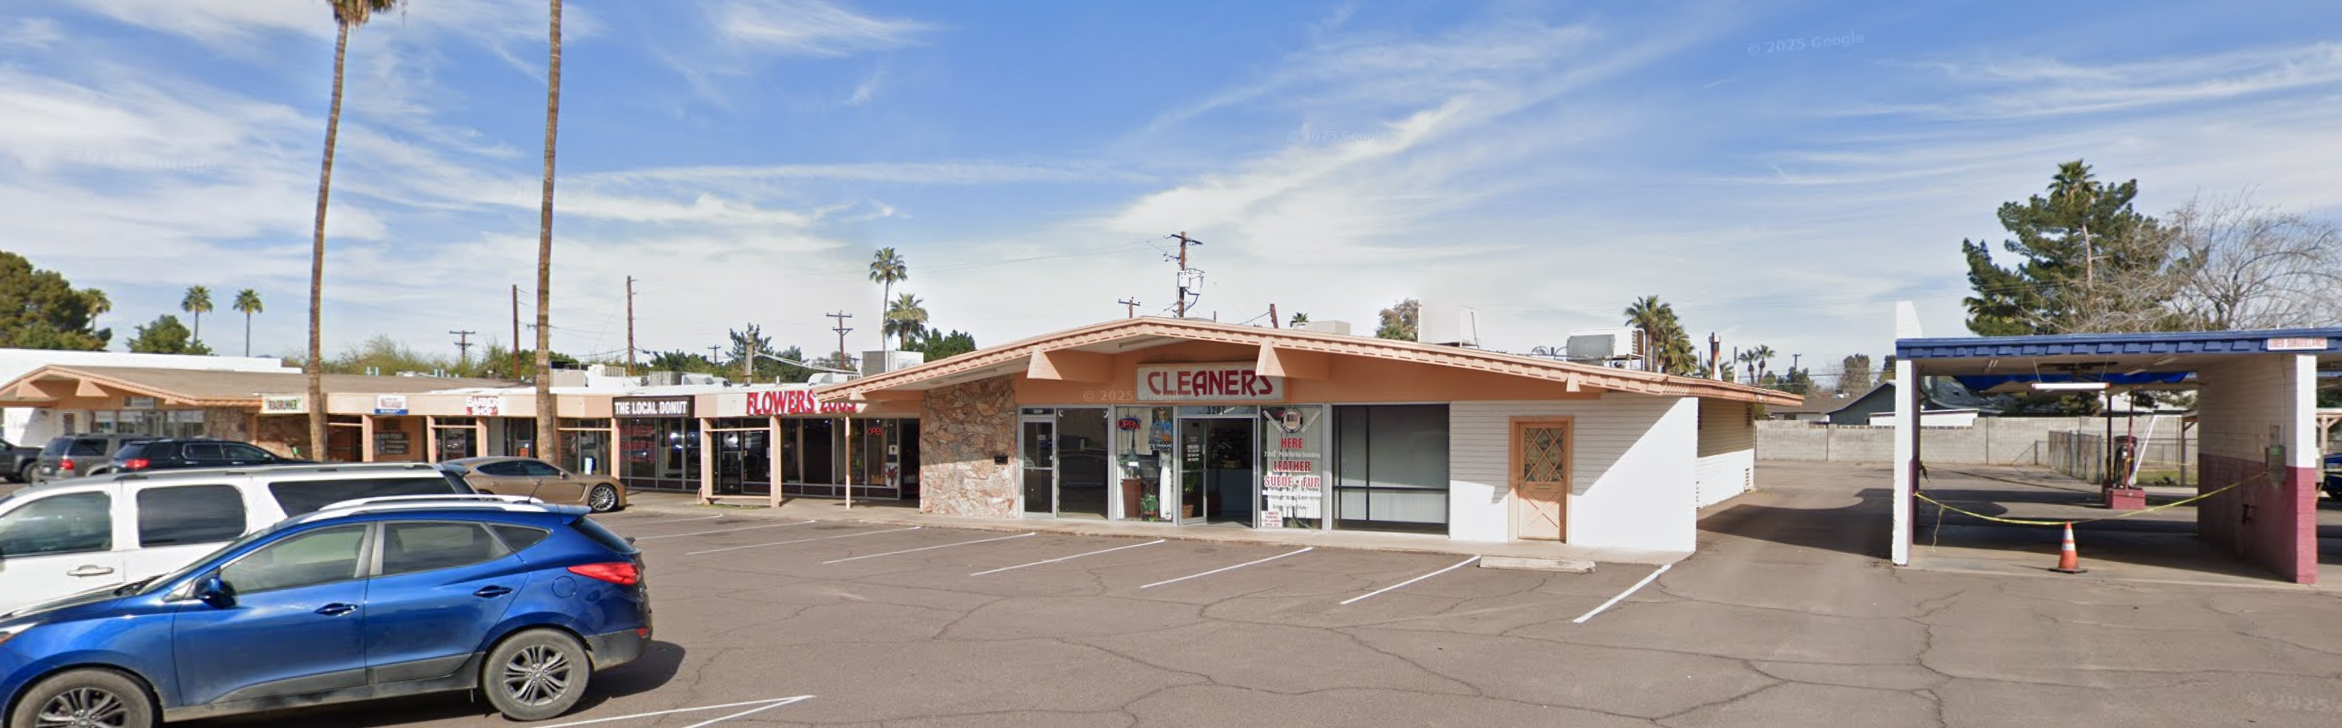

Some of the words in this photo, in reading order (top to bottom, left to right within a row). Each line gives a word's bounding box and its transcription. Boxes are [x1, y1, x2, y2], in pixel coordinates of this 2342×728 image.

[1147, 369, 1273, 397] CLEANERS
[614, 401, 630, 414] THE
[632, 401, 658, 414] LOCAL
[659, 400, 688, 414] DONUT
[746, 388, 816, 415] FLOWERS
[1117, 418, 1141, 430] OPEN
[1281, 437, 1303, 449] HERE
[1273, 460, 1311, 472] LEATHER
[1264, 475, 1293, 488] SUEDE
[1303, 476, 1320, 488] FUR
